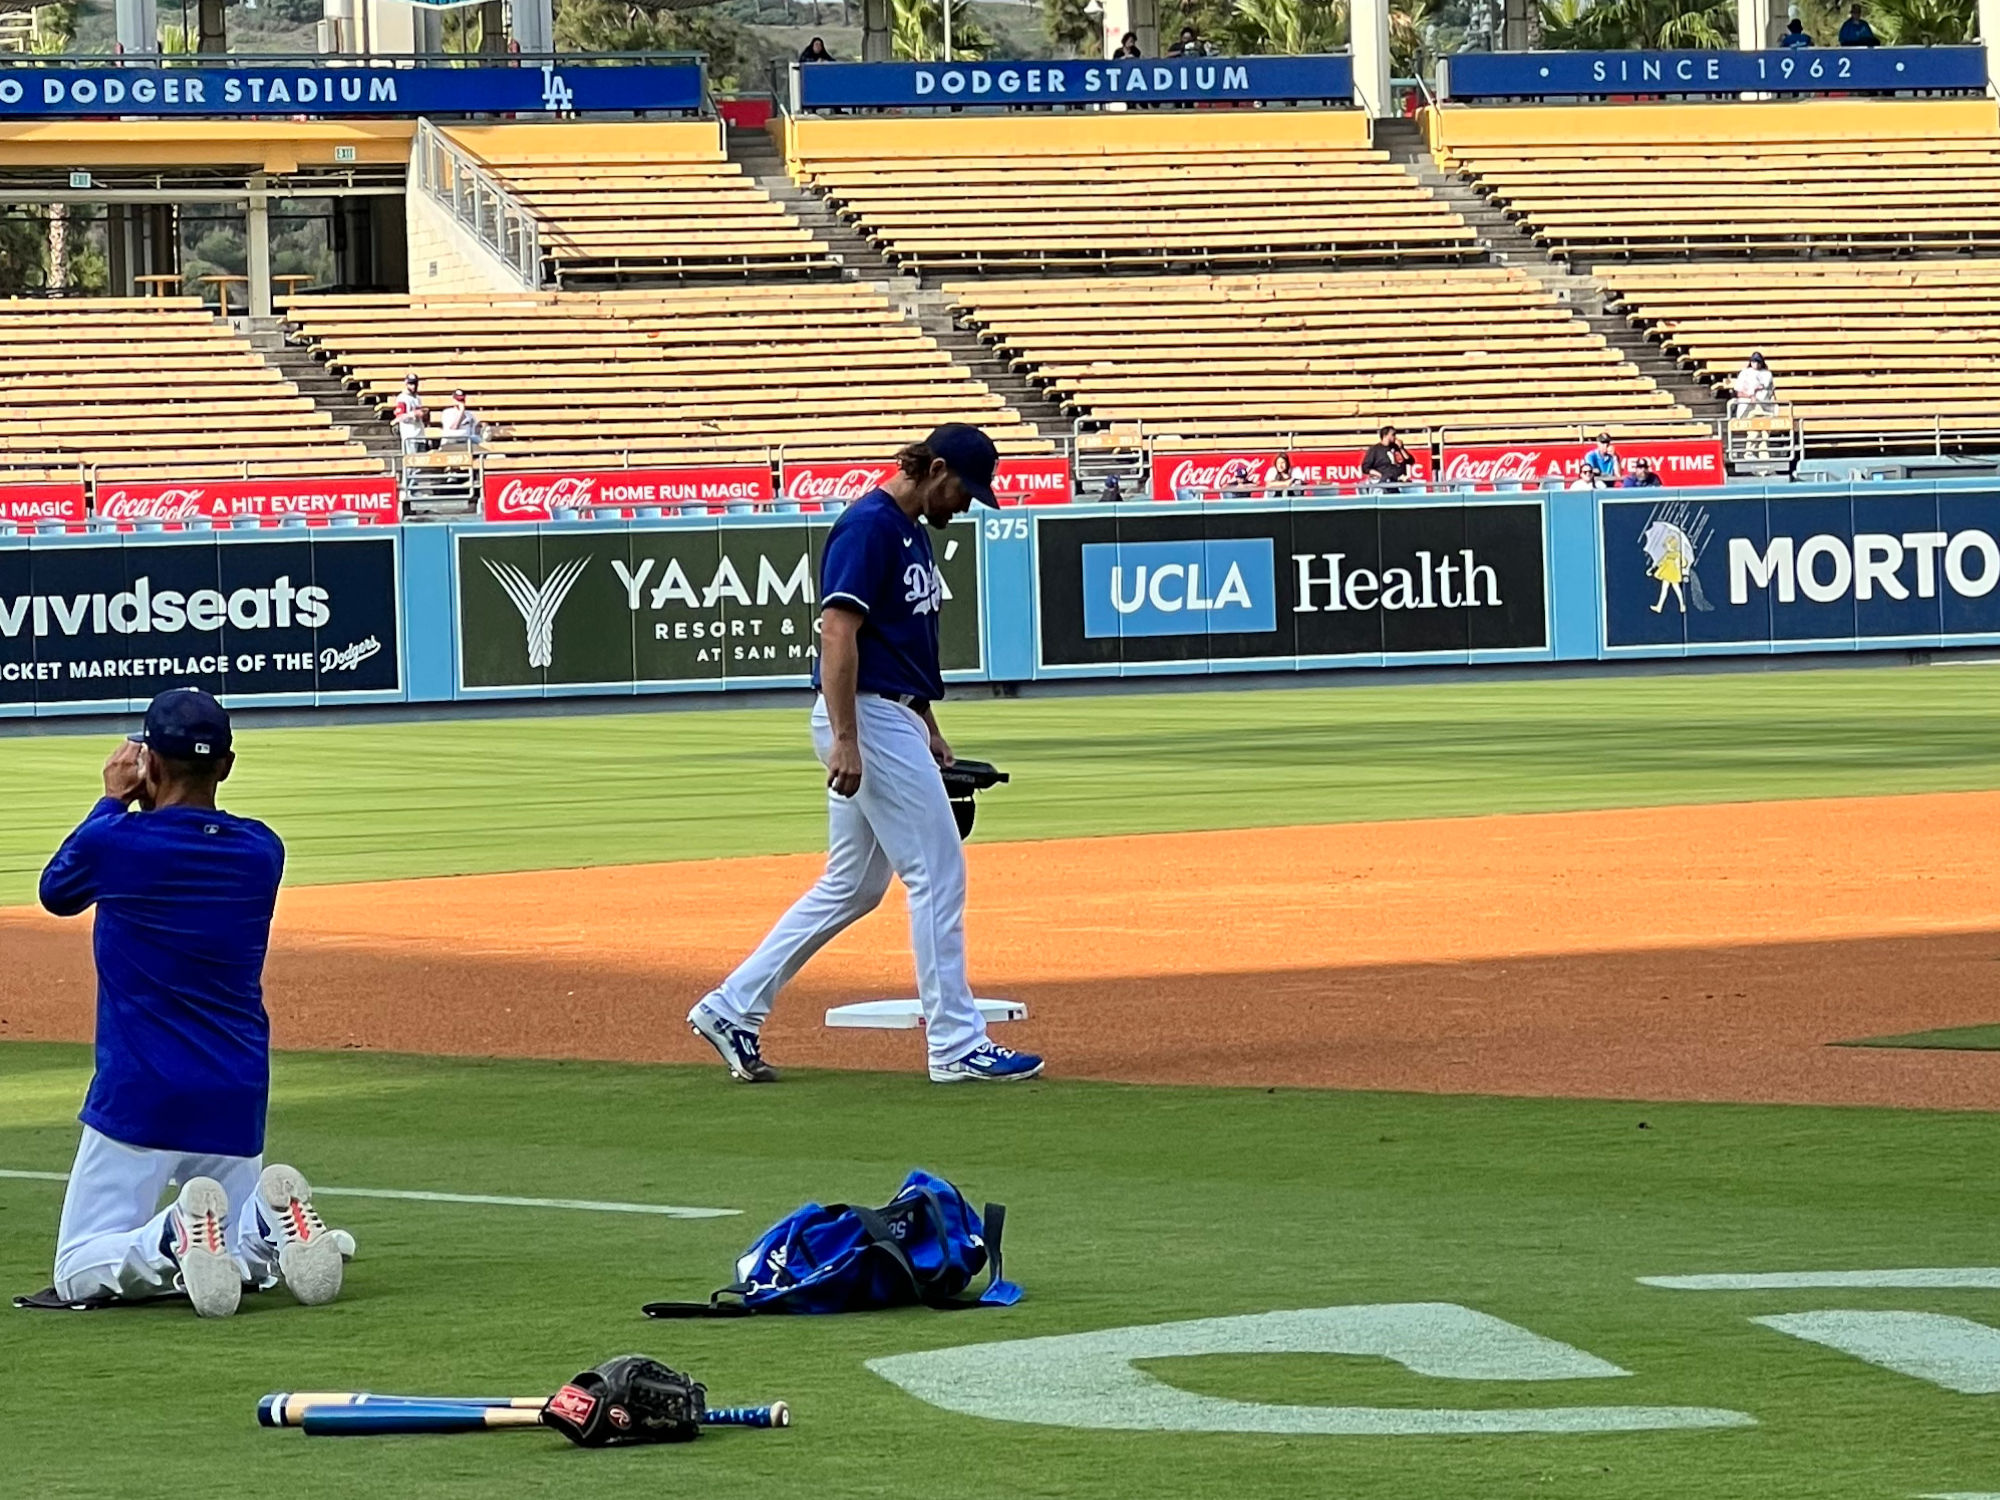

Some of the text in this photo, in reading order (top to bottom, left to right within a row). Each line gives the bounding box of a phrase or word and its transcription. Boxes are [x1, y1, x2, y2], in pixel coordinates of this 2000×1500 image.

[916, 66, 1249, 94] DODGER STADIUM
[1593, 58, 1851, 81] SINCE 1962
[44, 78, 206, 103] DODGER
[224, 77, 397, 102] STADIUM
[541, 65, 573, 110] LA
[1327, 465, 1363, 479] RUN
[1446, 451, 1541, 481] Coca-Cola
[1547, 459, 1562, 475] A
[1667, 454, 1715, 471] TIME
[498, 478, 760, 513] Coca-Cola HOME RUN MAGIC
[788, 468, 886, 500] Coca-Col
[1016, 473, 1065, 489] TIME
[12, 500, 74, 517] MAGIC
[102, 489, 393, 521] Coca-Cola A HIT EVERY TIME
[985, 518, 1028, 540] 375
[1110, 549, 1504, 614] UCLA Health
[0, 575, 330, 637] vividseats
[655, 619, 763, 640] RESORT
[780, 618, 795, 635] &
[0, 635, 381, 681] CKET MARKETPLACE OF THE Dodgers
[696, 647, 722, 662] AT
[734, 645, 776, 660] SAN
